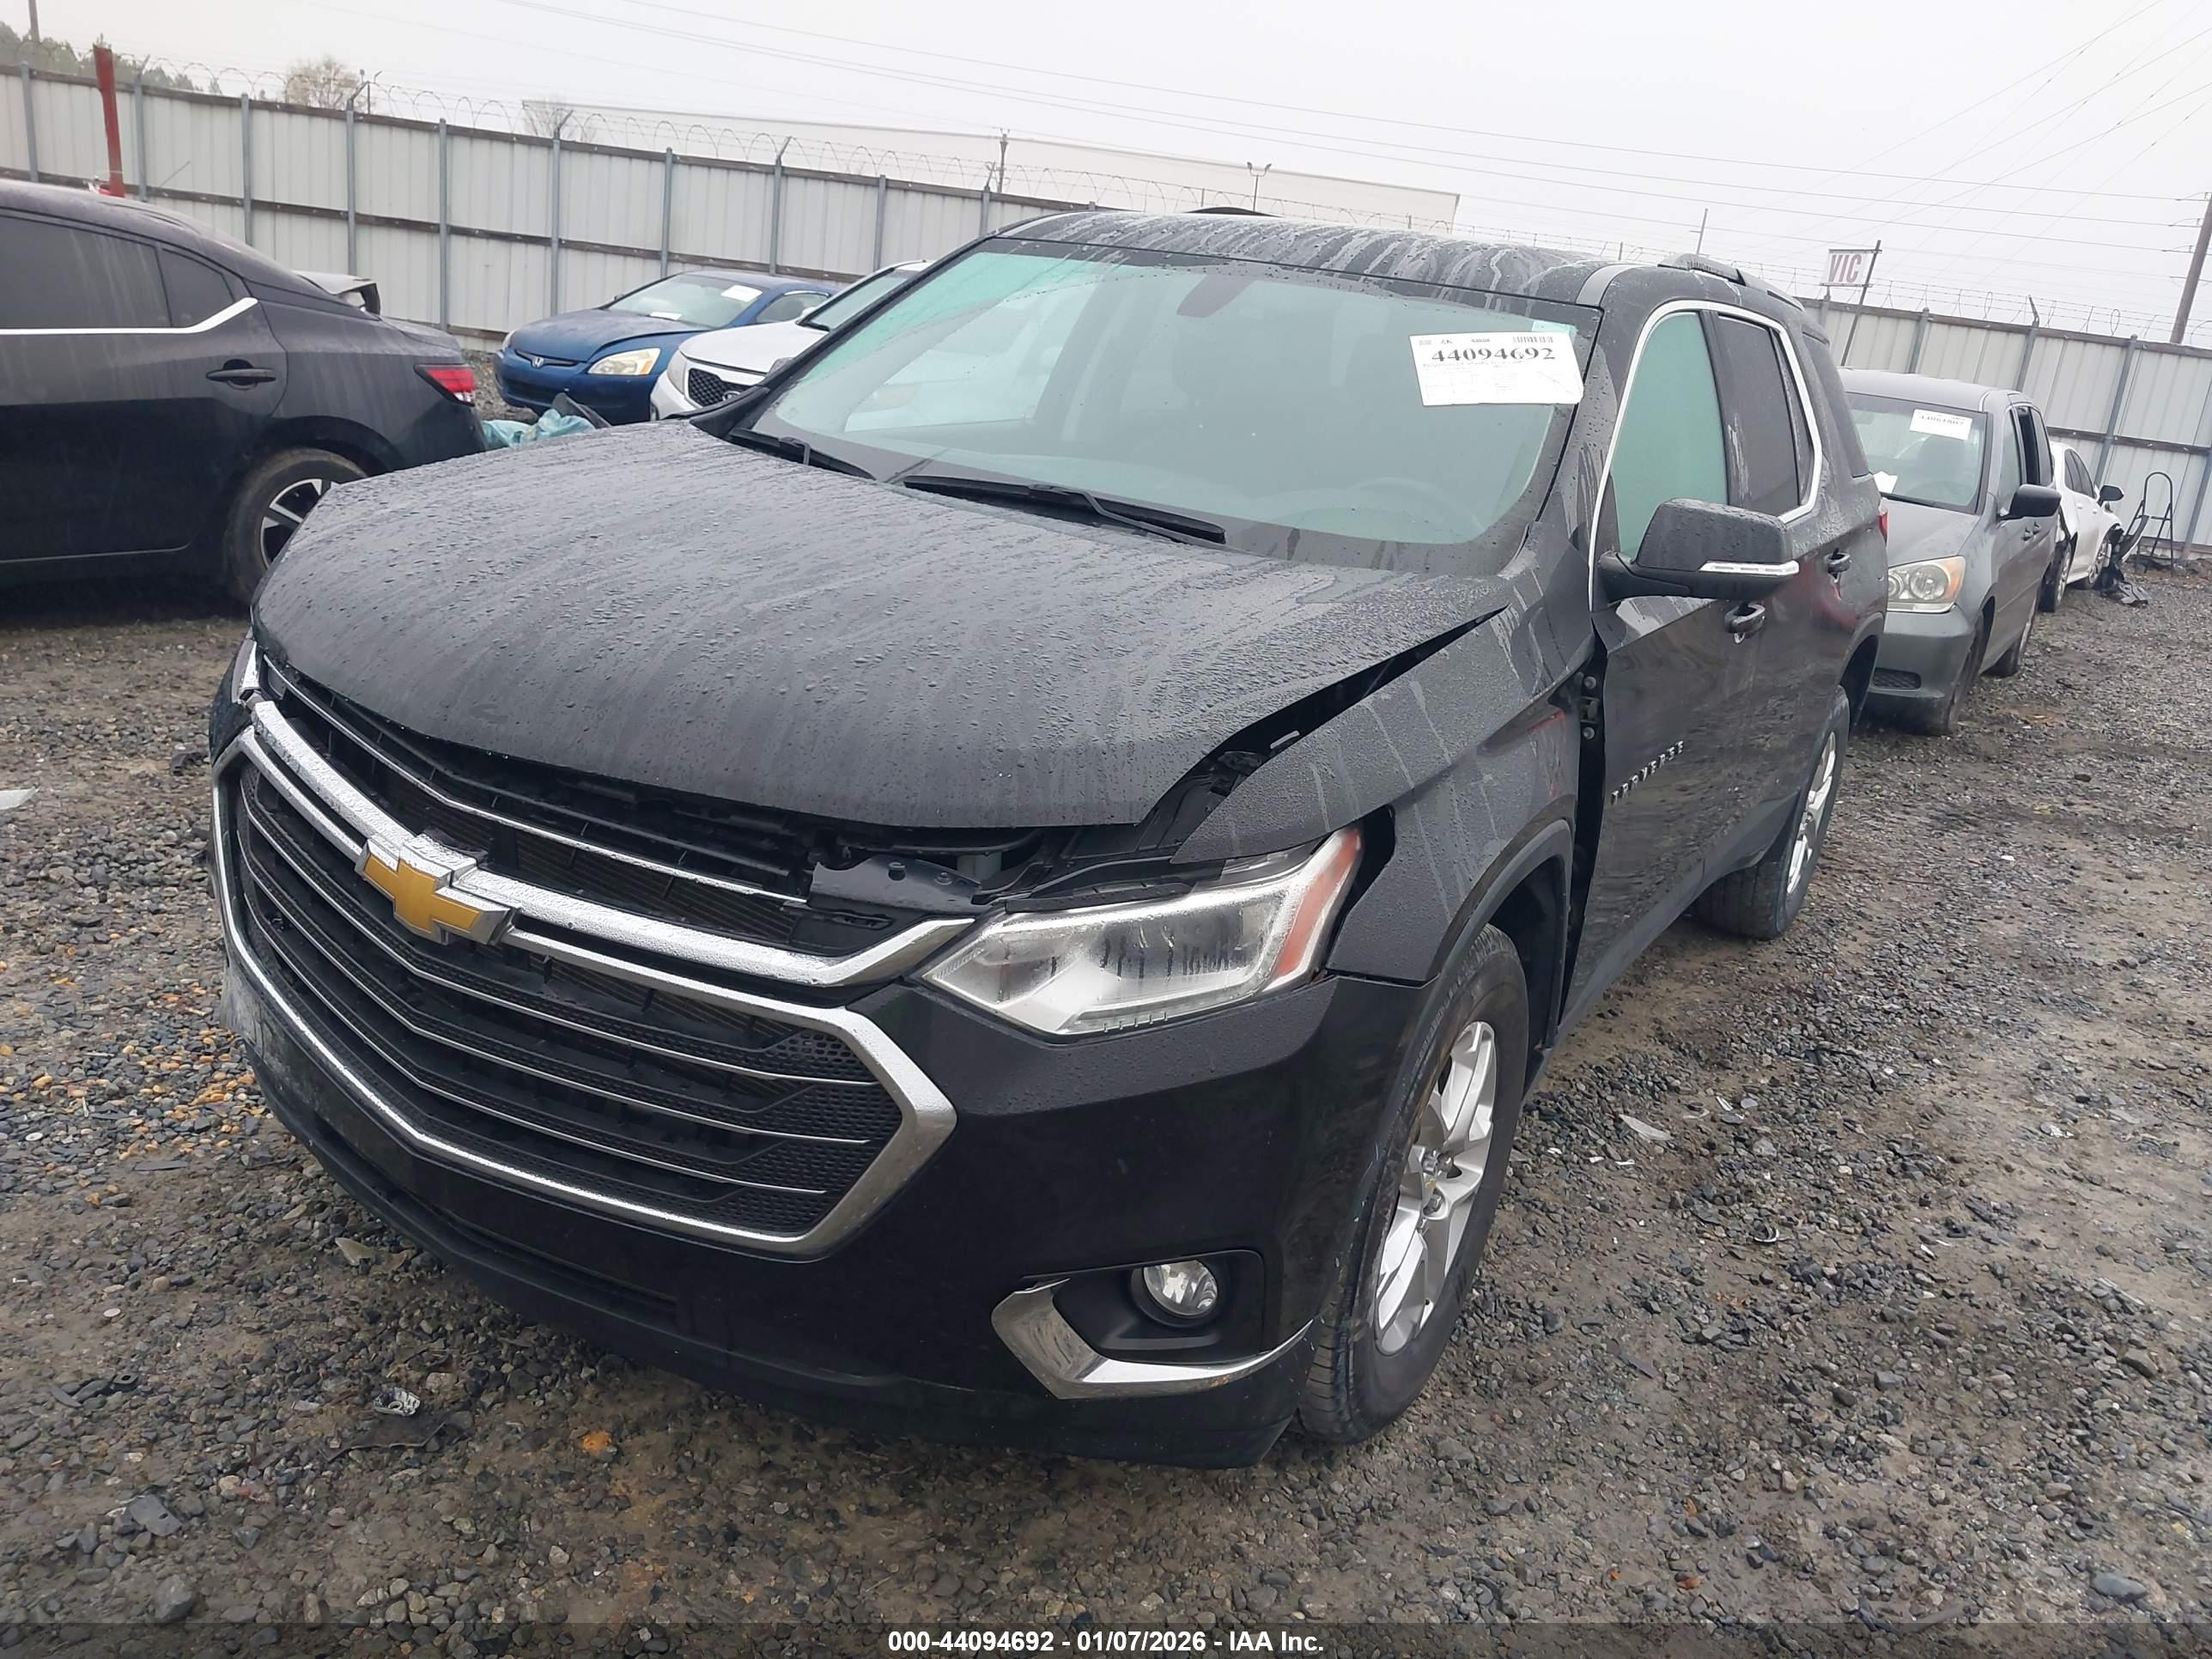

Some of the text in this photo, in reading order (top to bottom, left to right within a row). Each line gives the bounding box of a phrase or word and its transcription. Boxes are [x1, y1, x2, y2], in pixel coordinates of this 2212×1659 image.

[1828, 253, 1862, 283] VIC
[1431, 347, 1555, 362] 44094692
[1612, 740, 1684, 805] TRAVERSE
